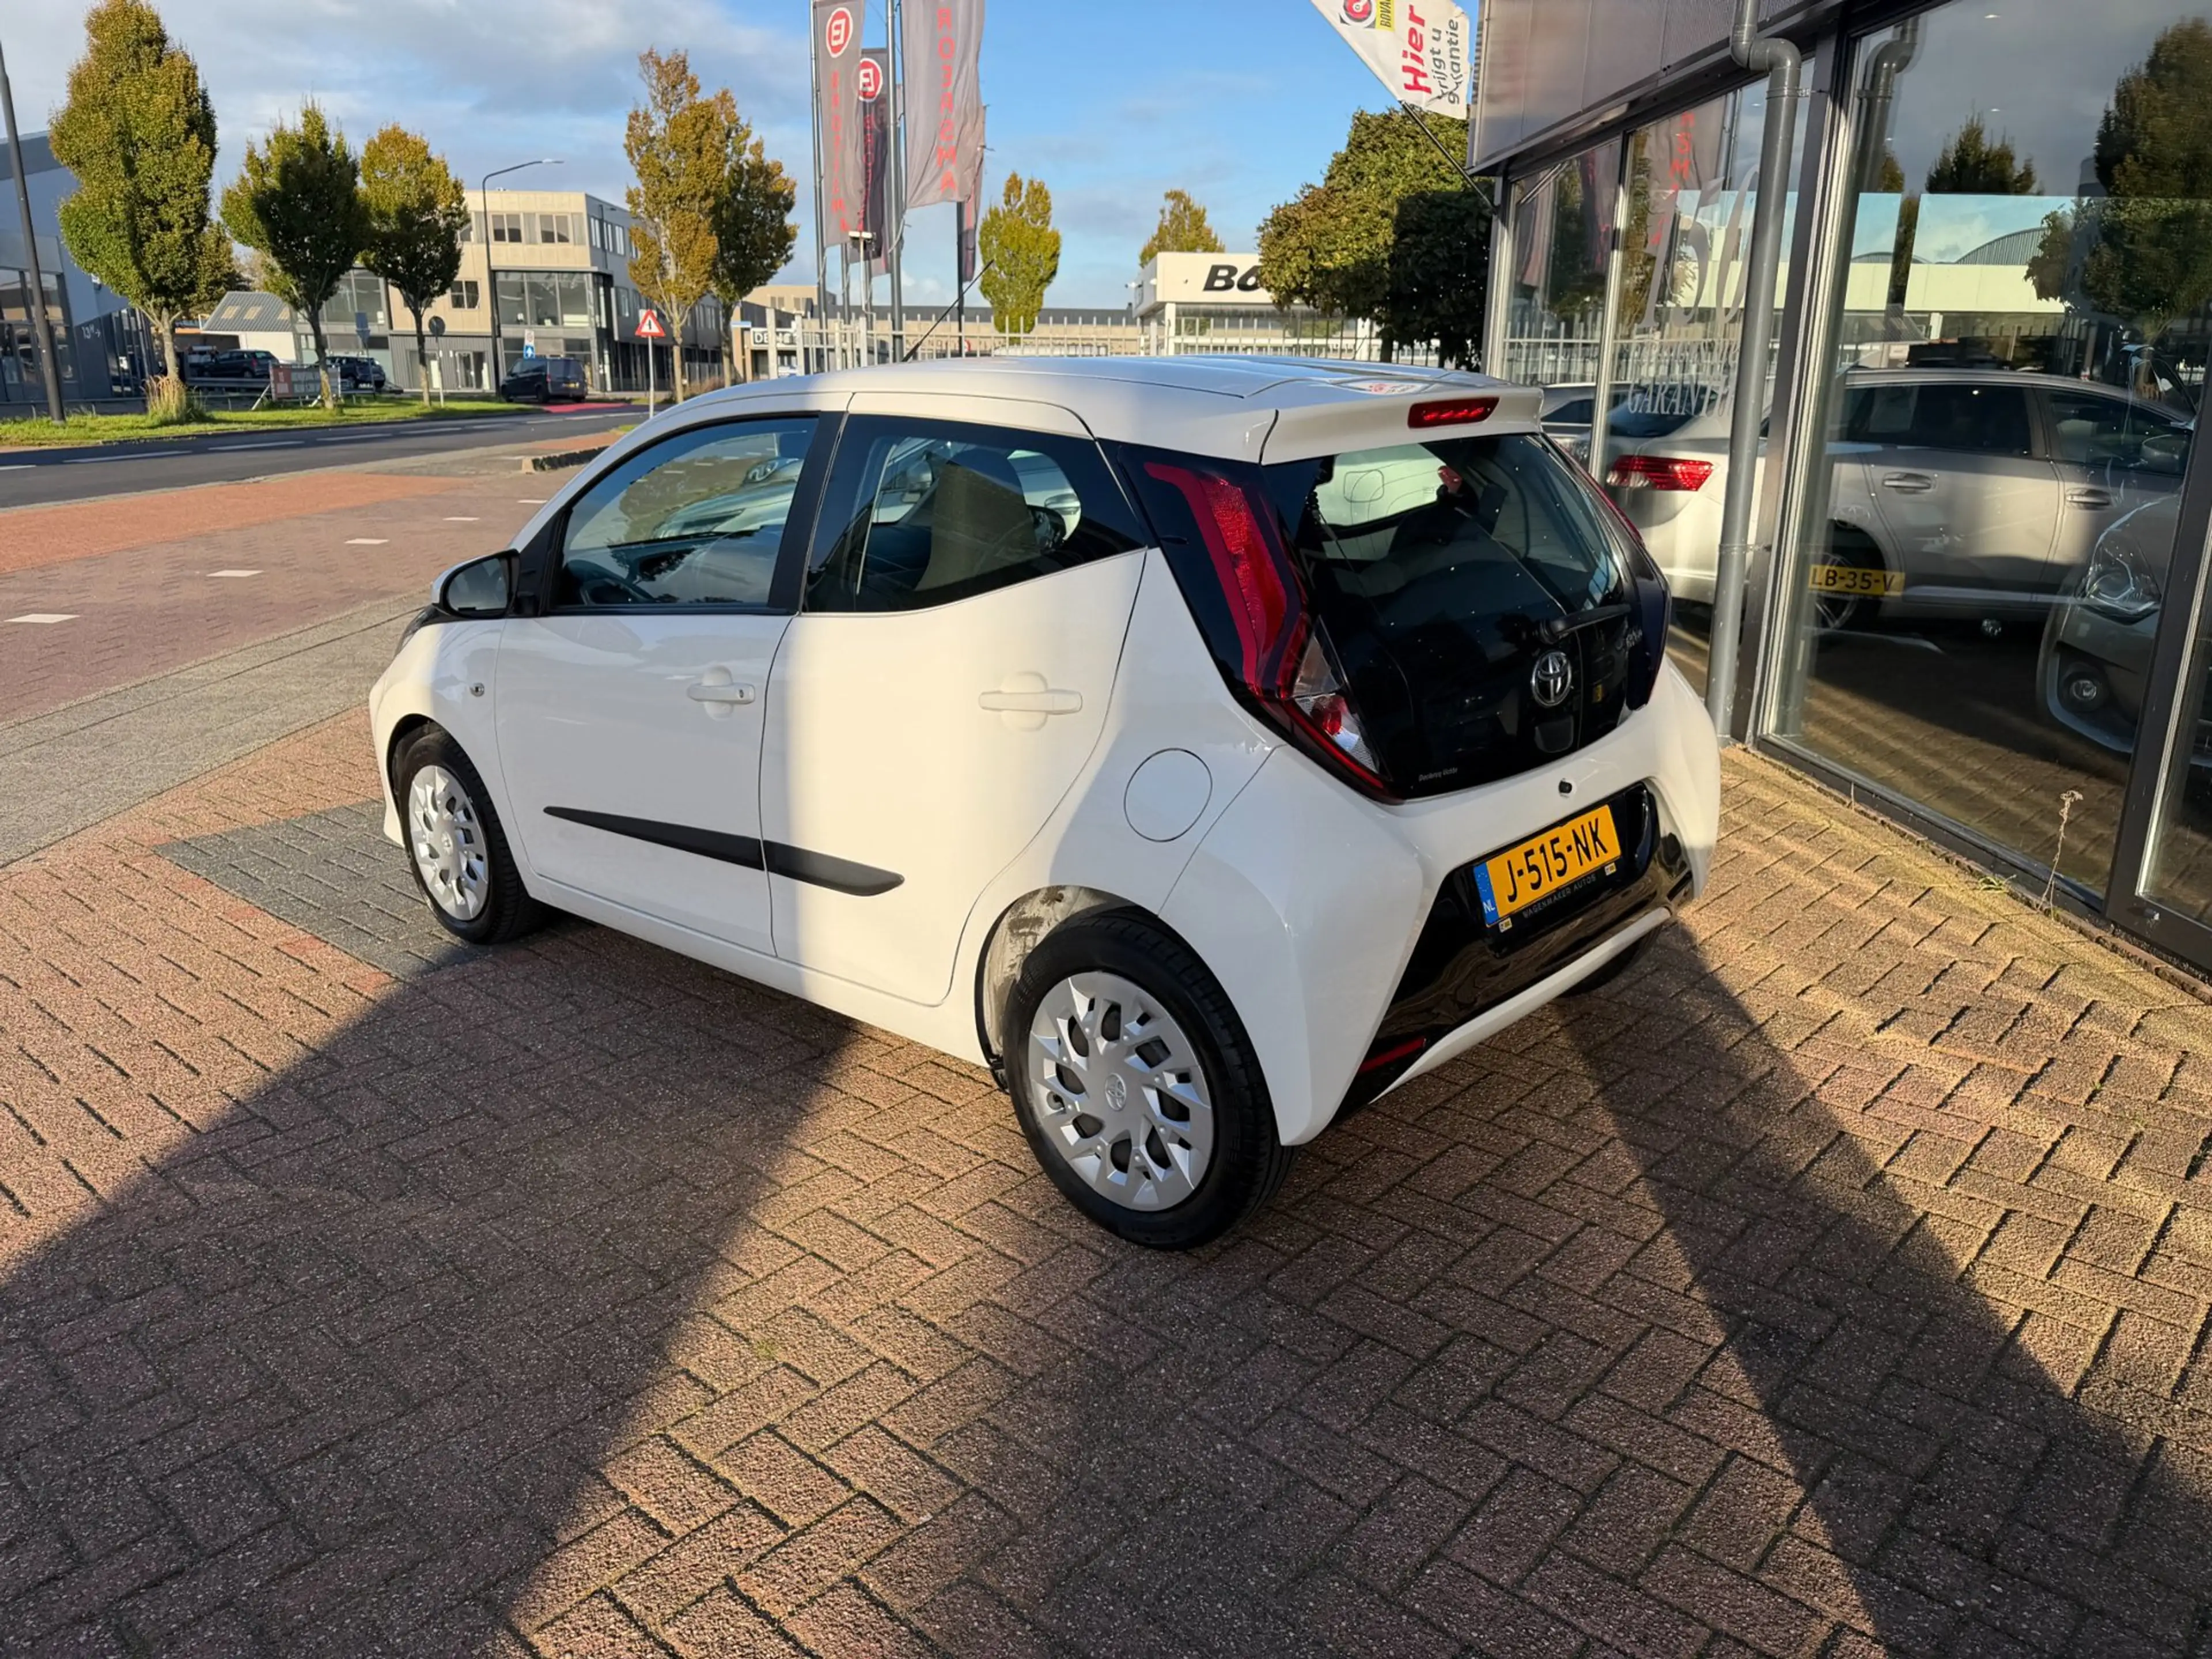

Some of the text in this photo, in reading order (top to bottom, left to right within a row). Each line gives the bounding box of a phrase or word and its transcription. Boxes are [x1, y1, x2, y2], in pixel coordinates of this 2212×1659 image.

[1380, 0, 1392, 28] BOVA
[1432, 28, 1442, 41] u
[1402, 4, 1432, 94] Hier
[1507, 818, 1608, 903] J-515-NK
[1573, 873, 1596, 892] AUTOS
[1483, 899, 1495, 913] NL
